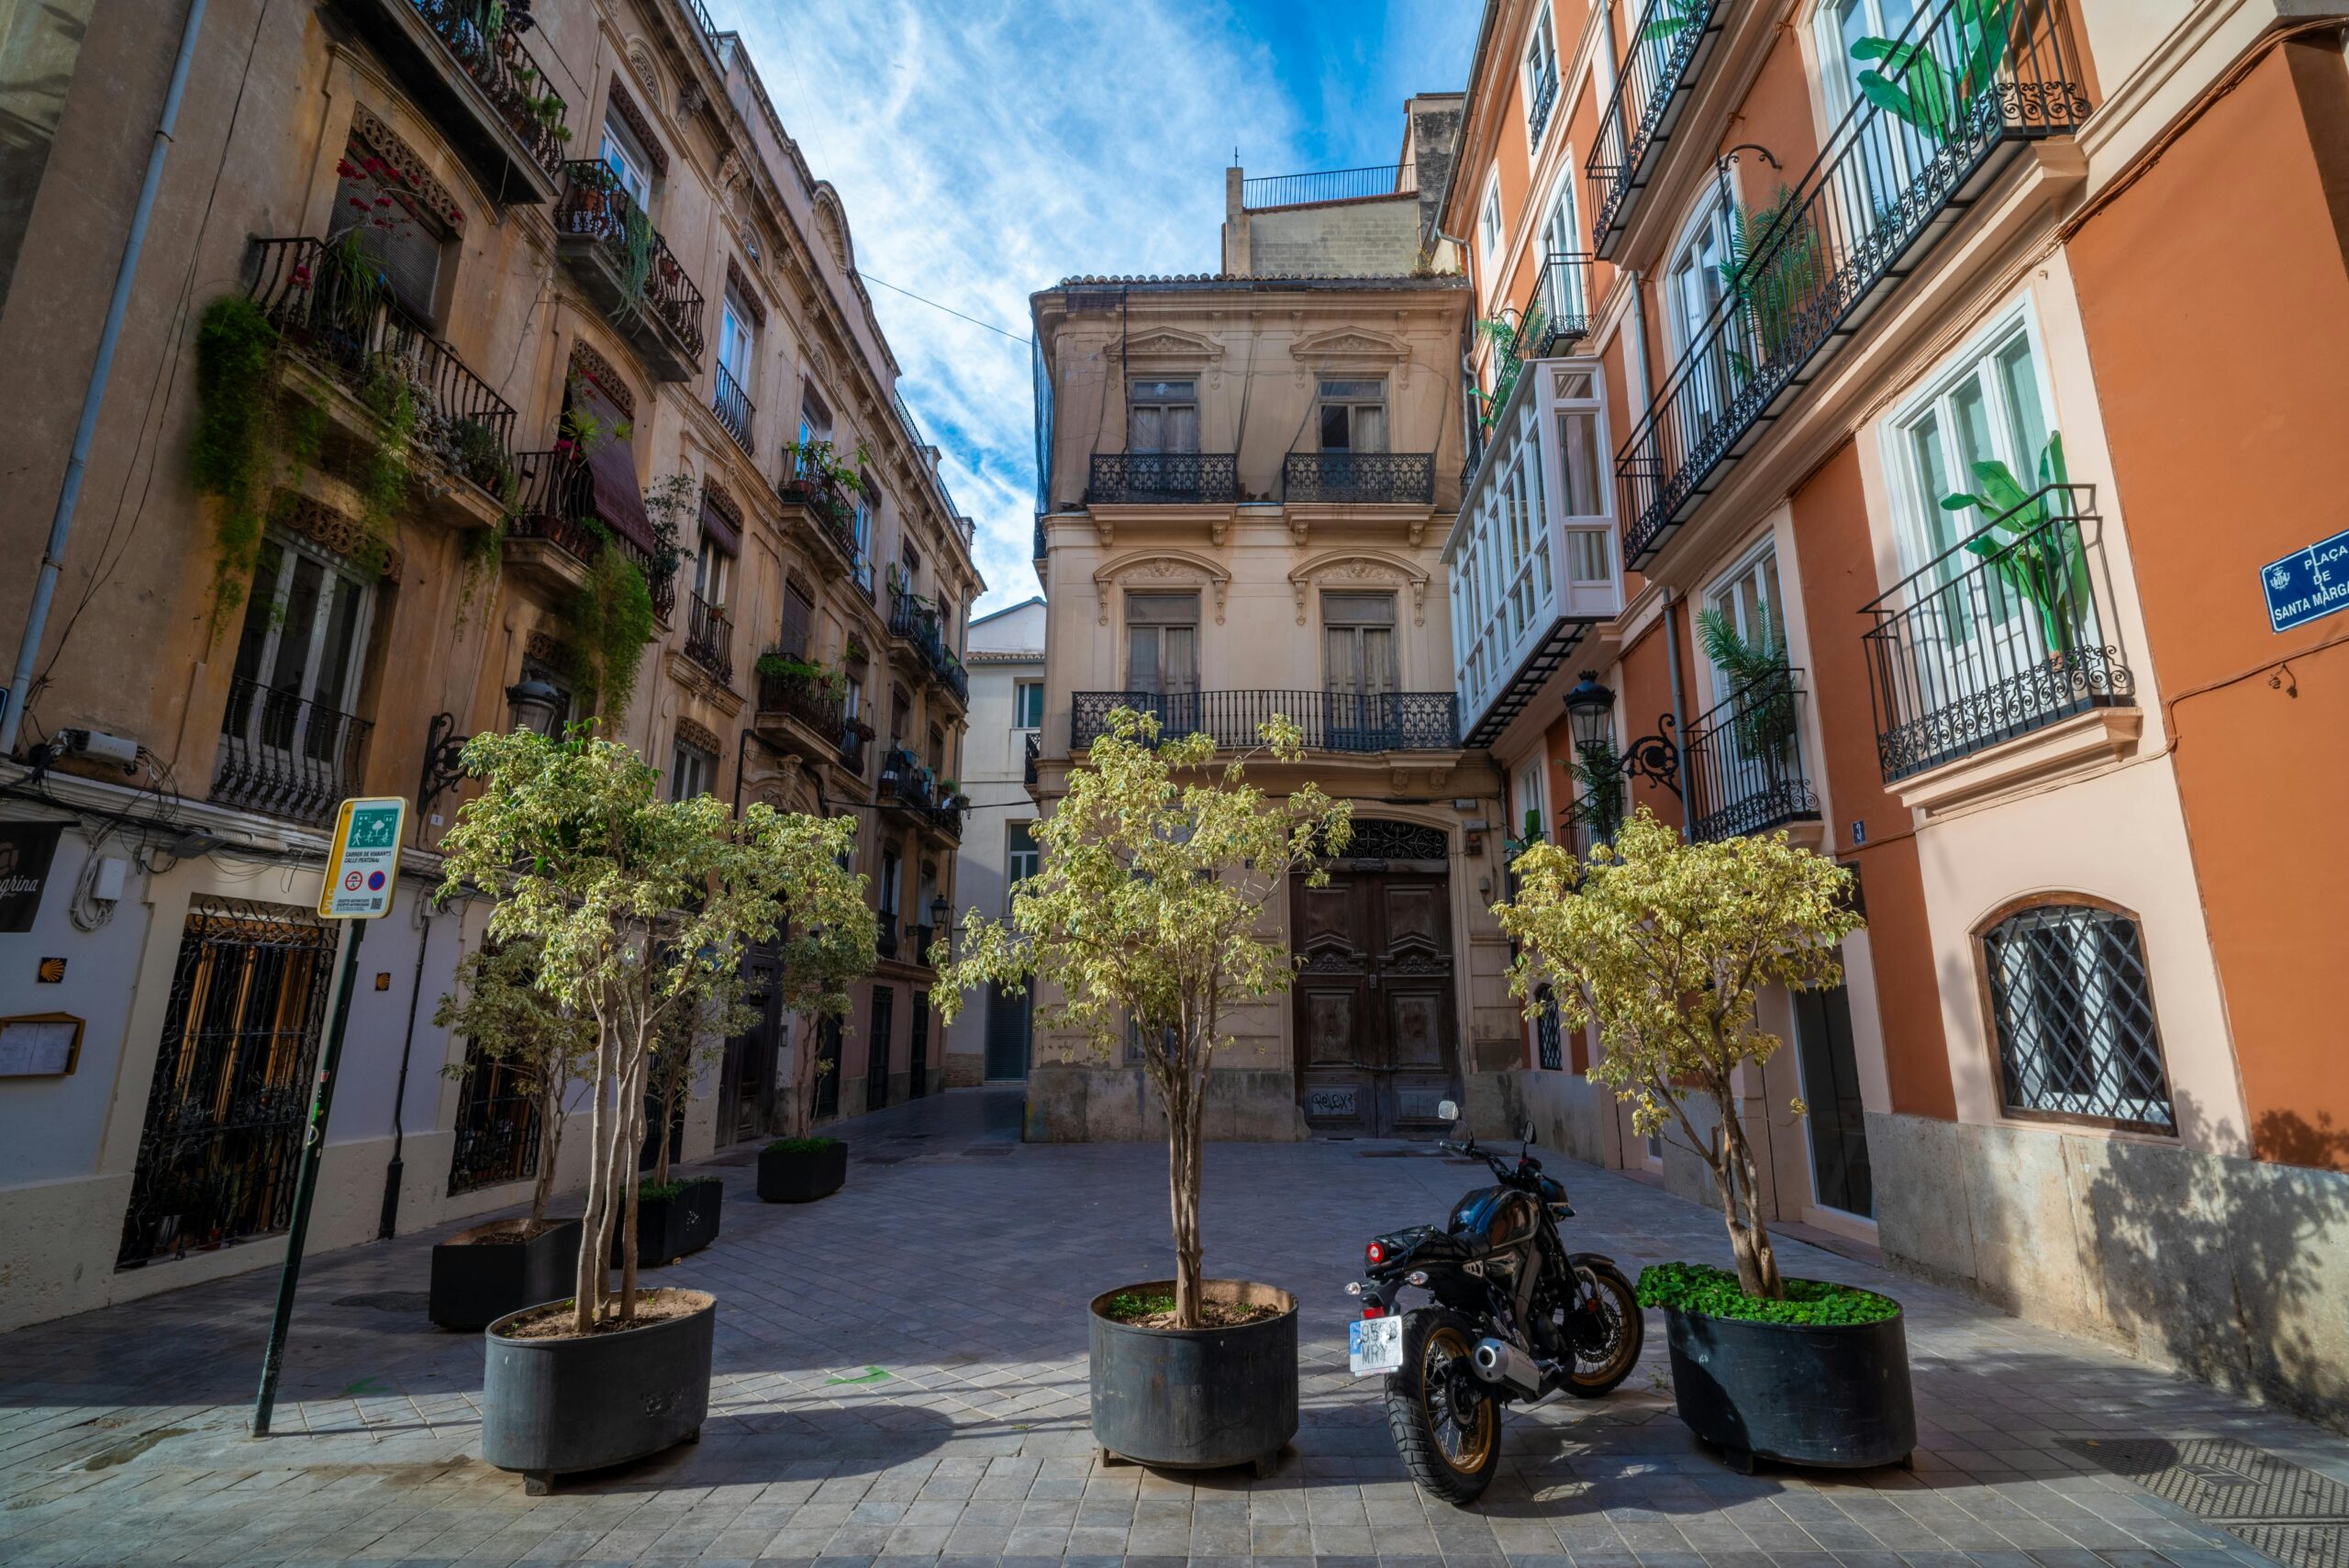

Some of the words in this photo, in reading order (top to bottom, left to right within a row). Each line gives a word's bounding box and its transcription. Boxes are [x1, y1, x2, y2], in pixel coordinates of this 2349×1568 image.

[2304, 545, 2348, 570] PLAÇA
[2313, 570, 2332, 585] DE
[2275, 598, 2311, 620] SANTA
[2312, 581, 2349, 606] MARG
[1856, 823, 1862, 840] 3
